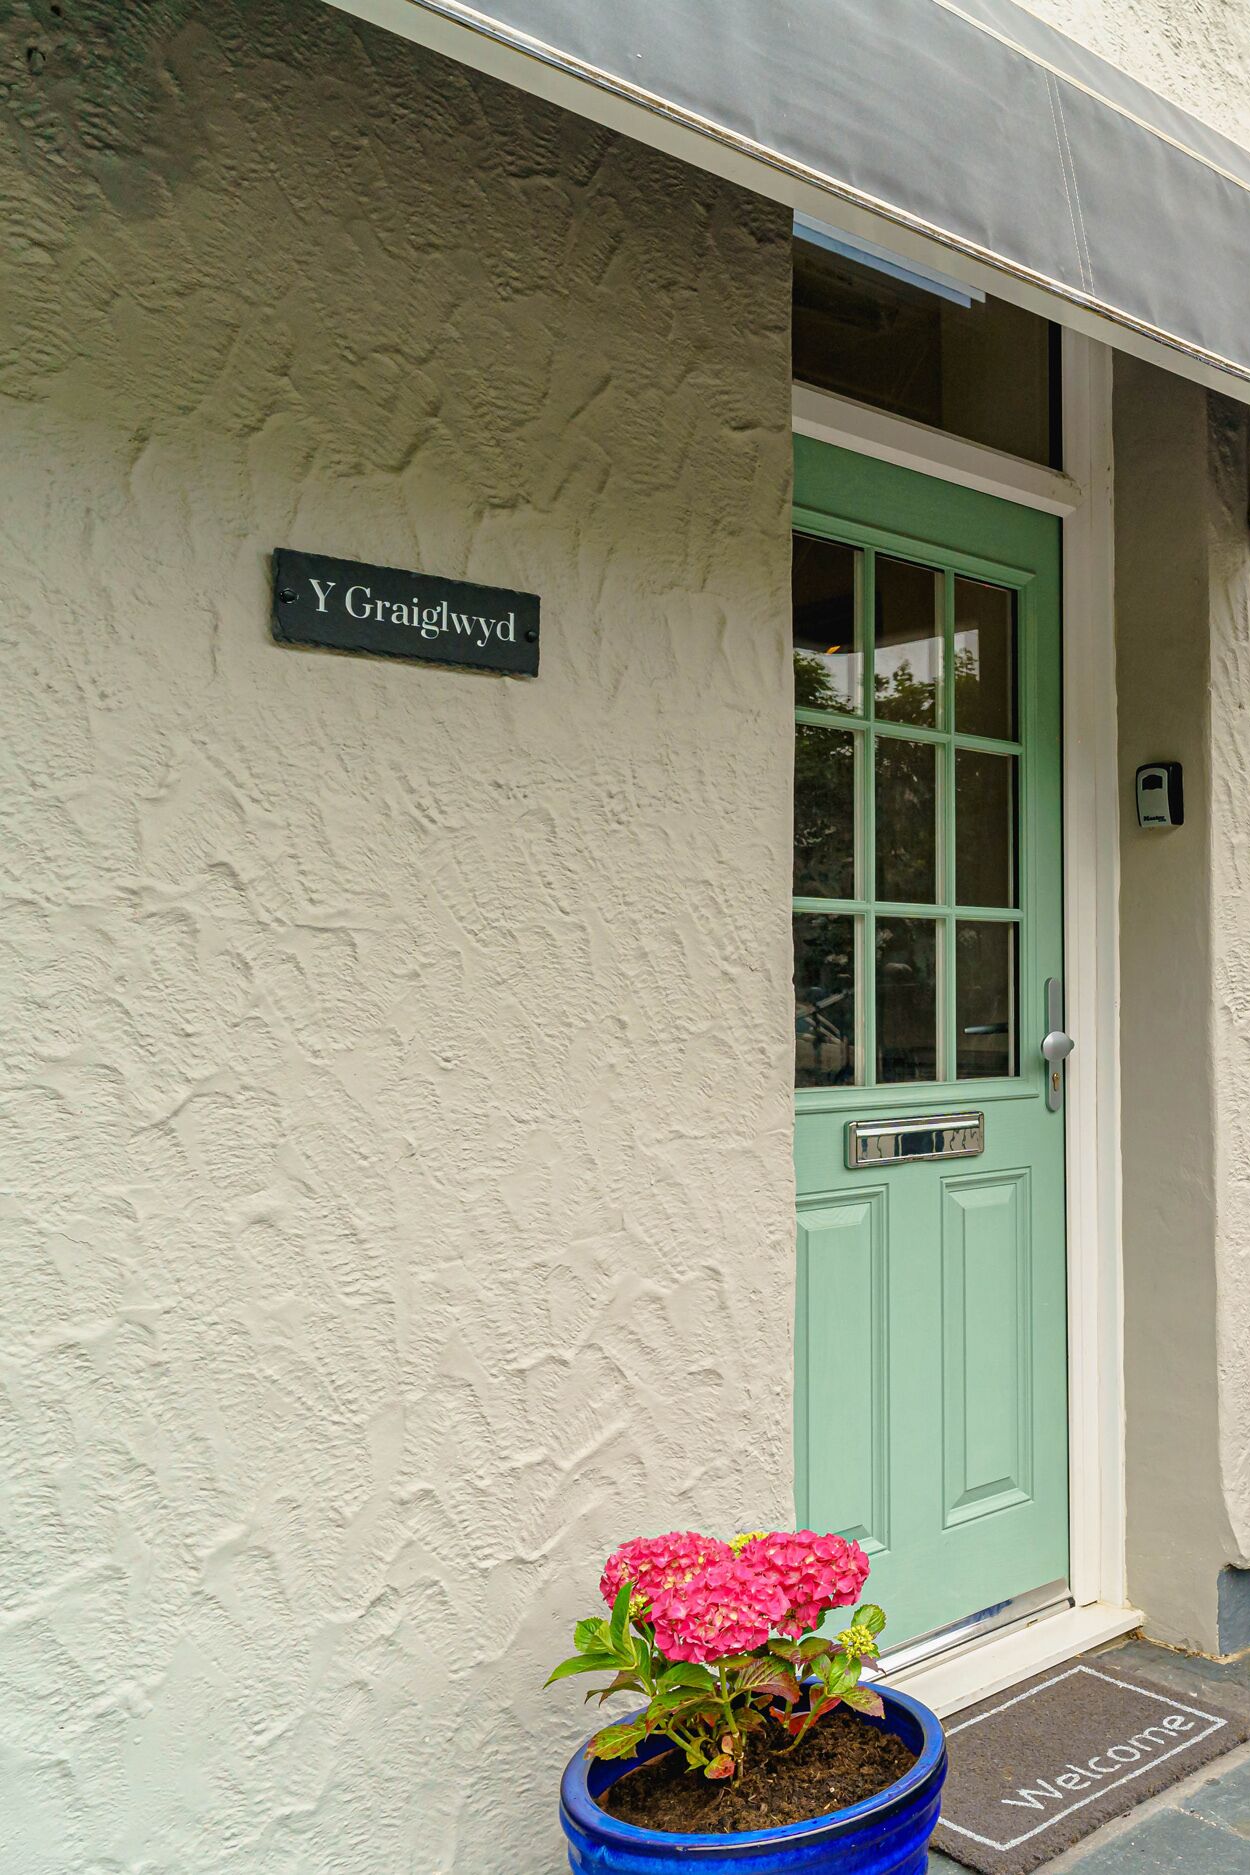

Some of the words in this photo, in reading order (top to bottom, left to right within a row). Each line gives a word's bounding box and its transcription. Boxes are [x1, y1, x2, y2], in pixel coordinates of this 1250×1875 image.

[308, 578, 336, 613] Y
[345, 585, 516, 647] Graiglwyd
[1000, 1714, 1195, 1810] Welcome
